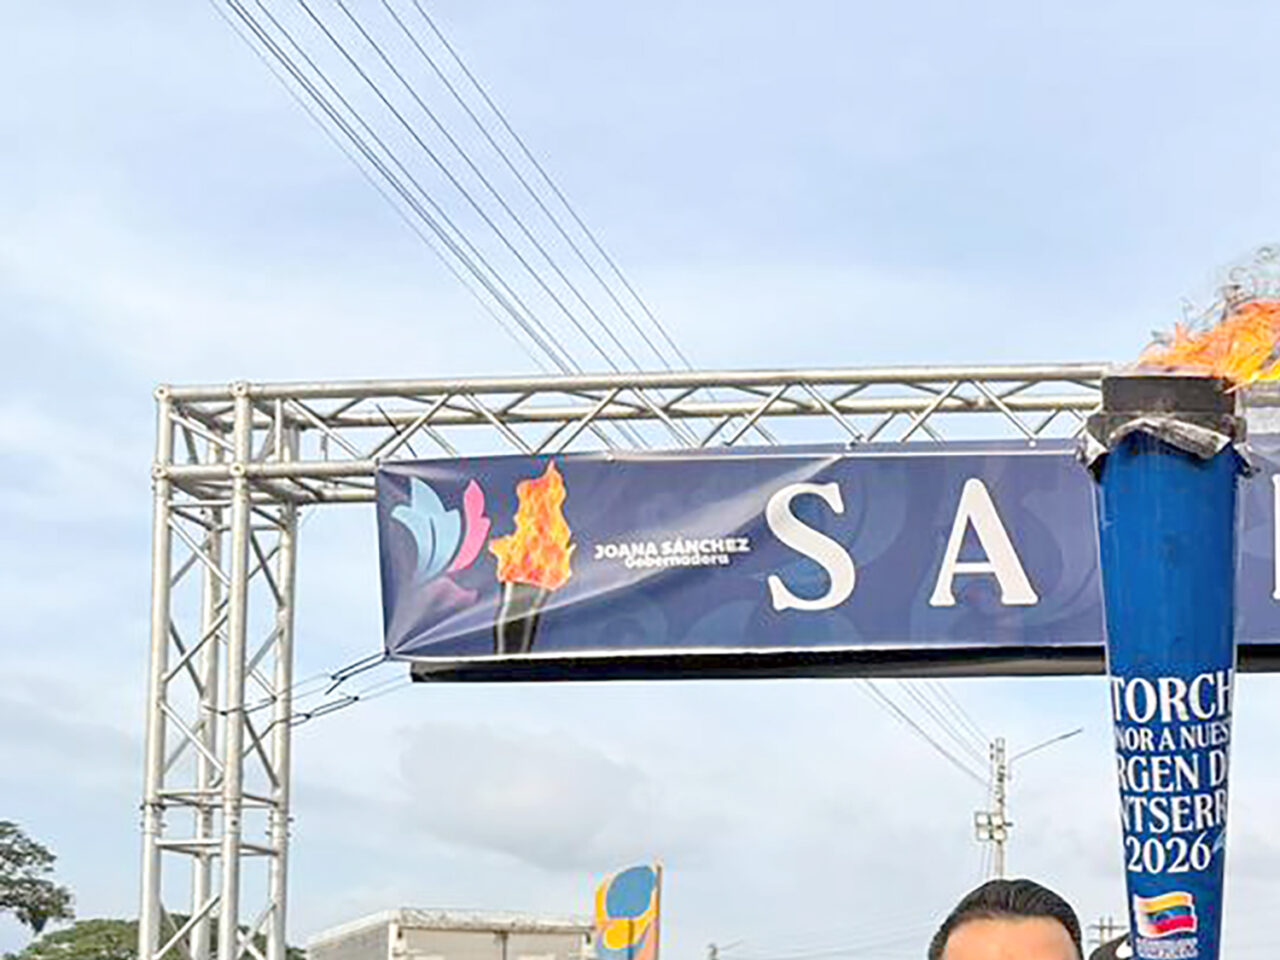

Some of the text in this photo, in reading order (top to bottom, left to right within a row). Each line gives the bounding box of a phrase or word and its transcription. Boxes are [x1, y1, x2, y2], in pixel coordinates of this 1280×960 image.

[594, 535, 750, 559] JOANA SÁNCHEZ
[1158, 727, 1176, 751] A
[1126, 832, 1211, 874] 2026
